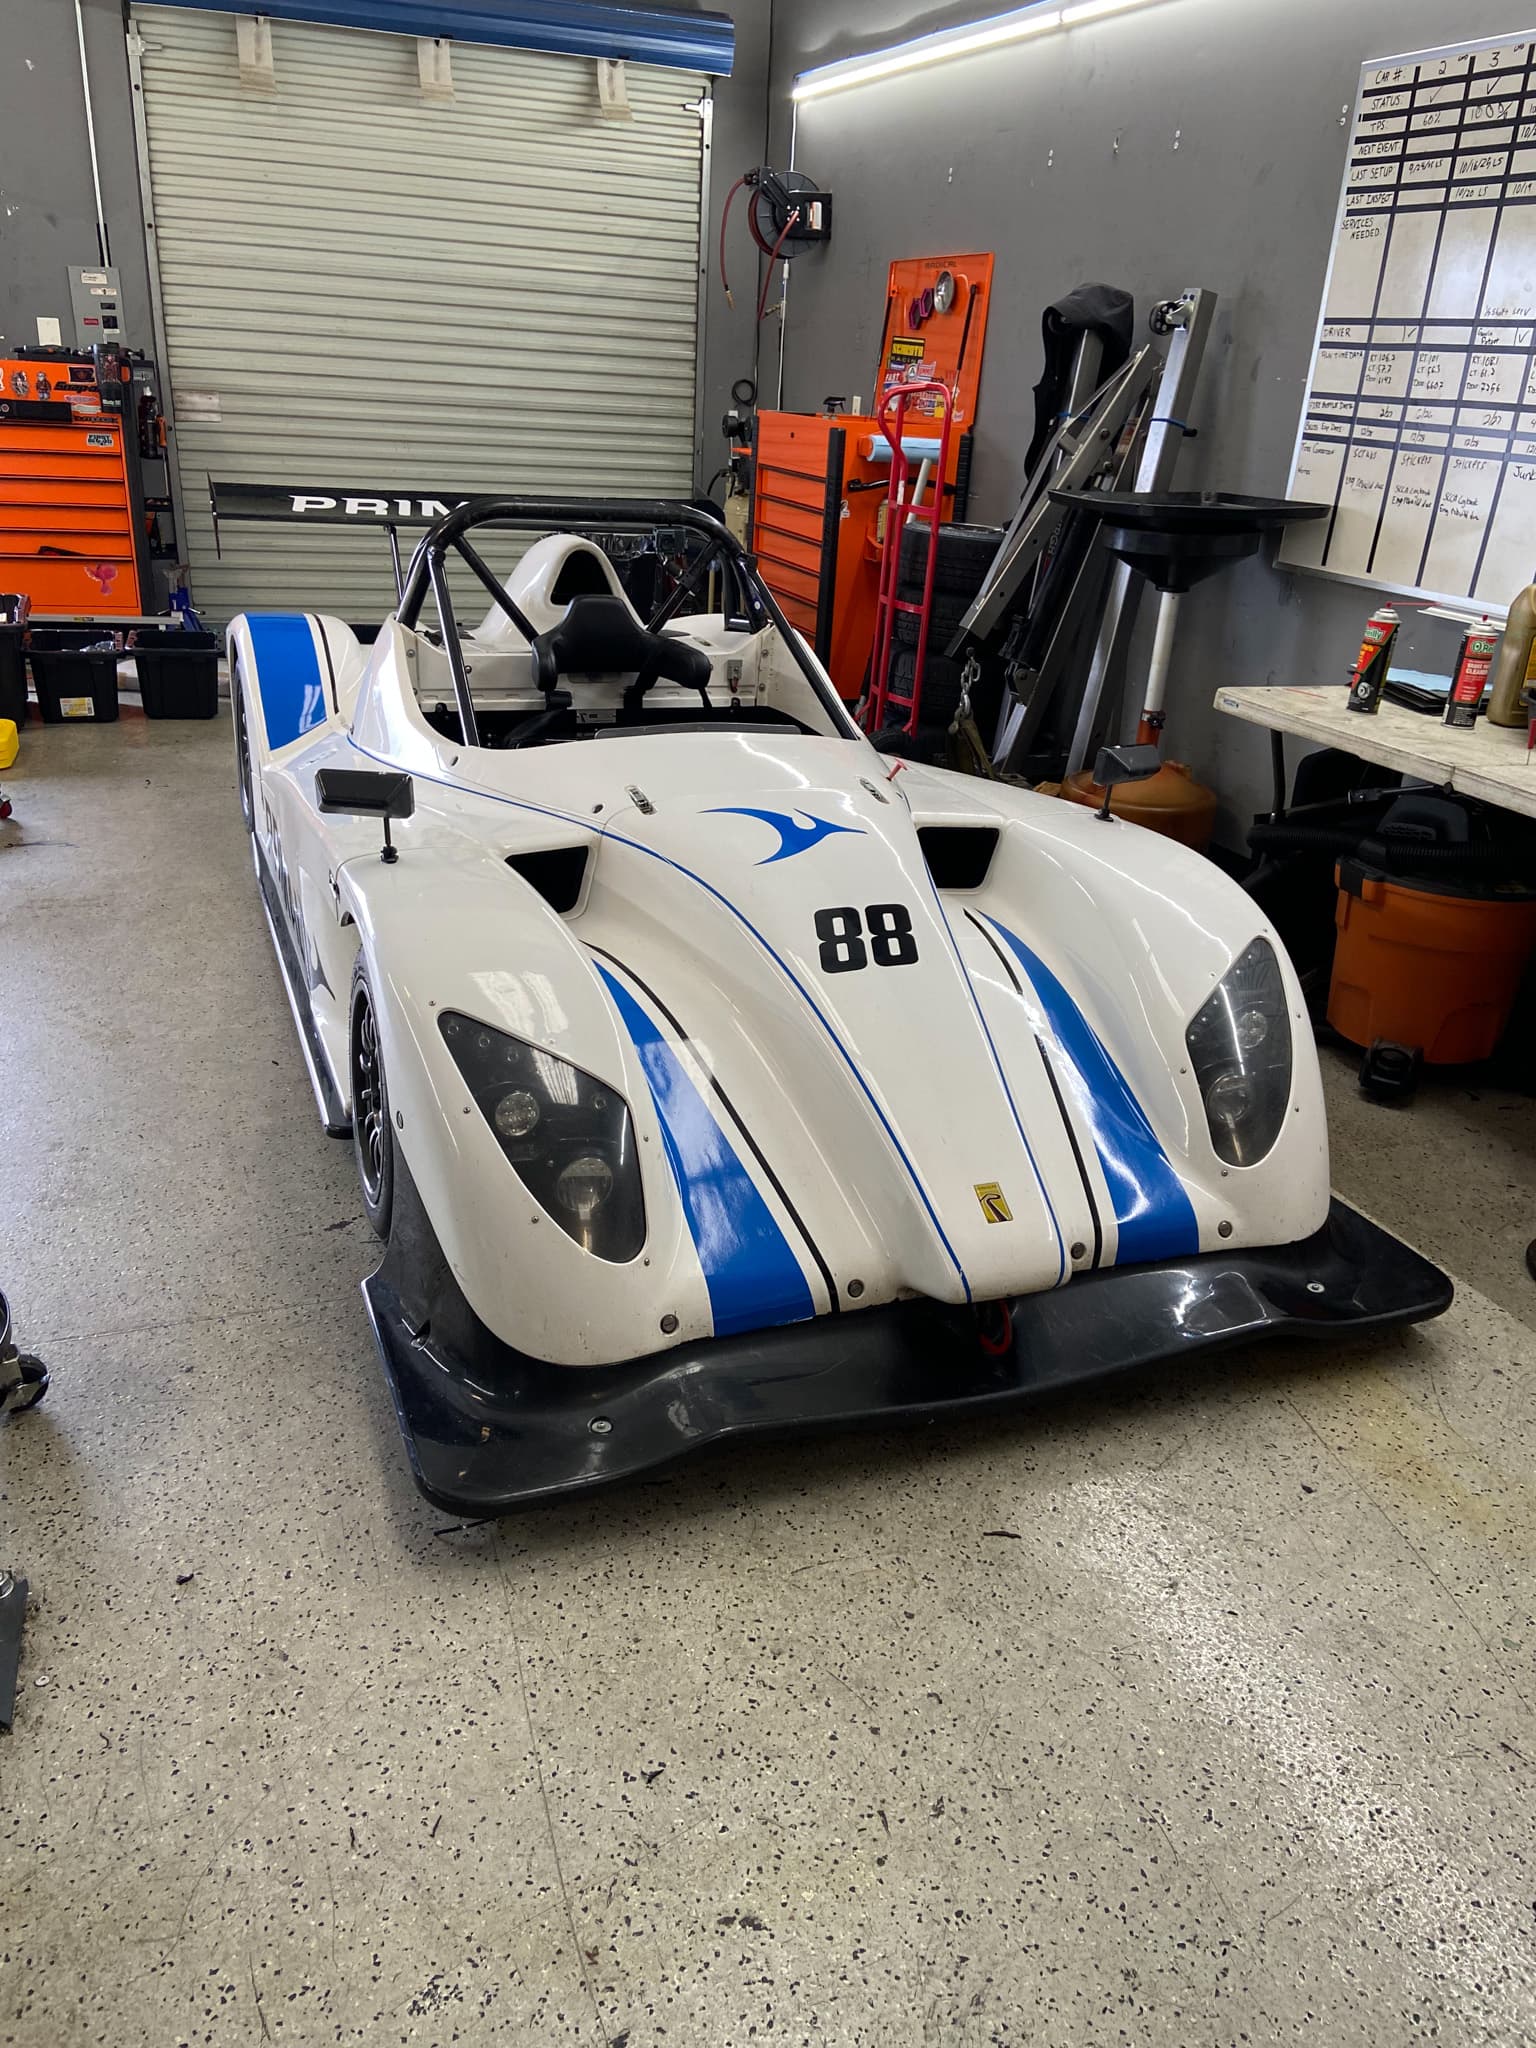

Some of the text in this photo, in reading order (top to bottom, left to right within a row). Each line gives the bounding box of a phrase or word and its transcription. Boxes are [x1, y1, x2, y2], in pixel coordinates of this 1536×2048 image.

[1439, 60, 1447, 74] 2
[1489, 51, 1500, 67] 3
[814, 904, 919, 973] 88
